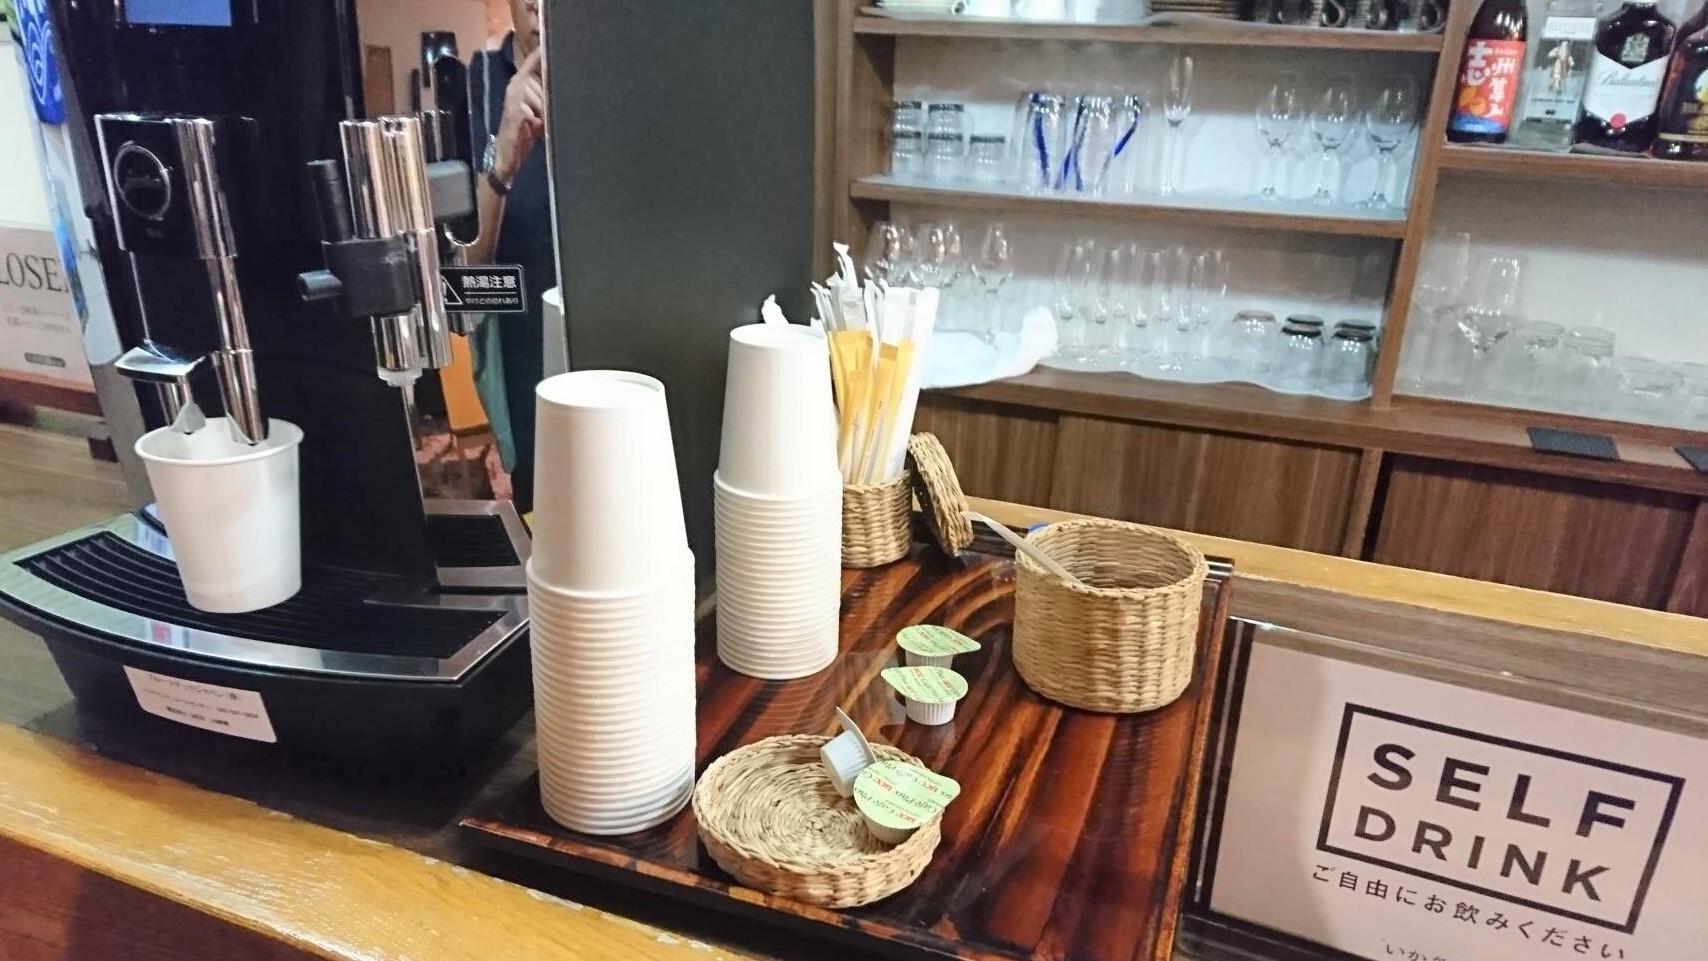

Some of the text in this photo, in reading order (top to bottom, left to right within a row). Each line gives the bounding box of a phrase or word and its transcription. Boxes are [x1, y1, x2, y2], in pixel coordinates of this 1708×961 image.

[0, 252, 70, 293] OSE
[462, 275, 517, 289] 熱湯注意
[1367, 743, 1636, 838] SELF
[1354, 805, 1611, 902] DRINK
[1312, 863, 1625, 959] ご自由にお飲みください
